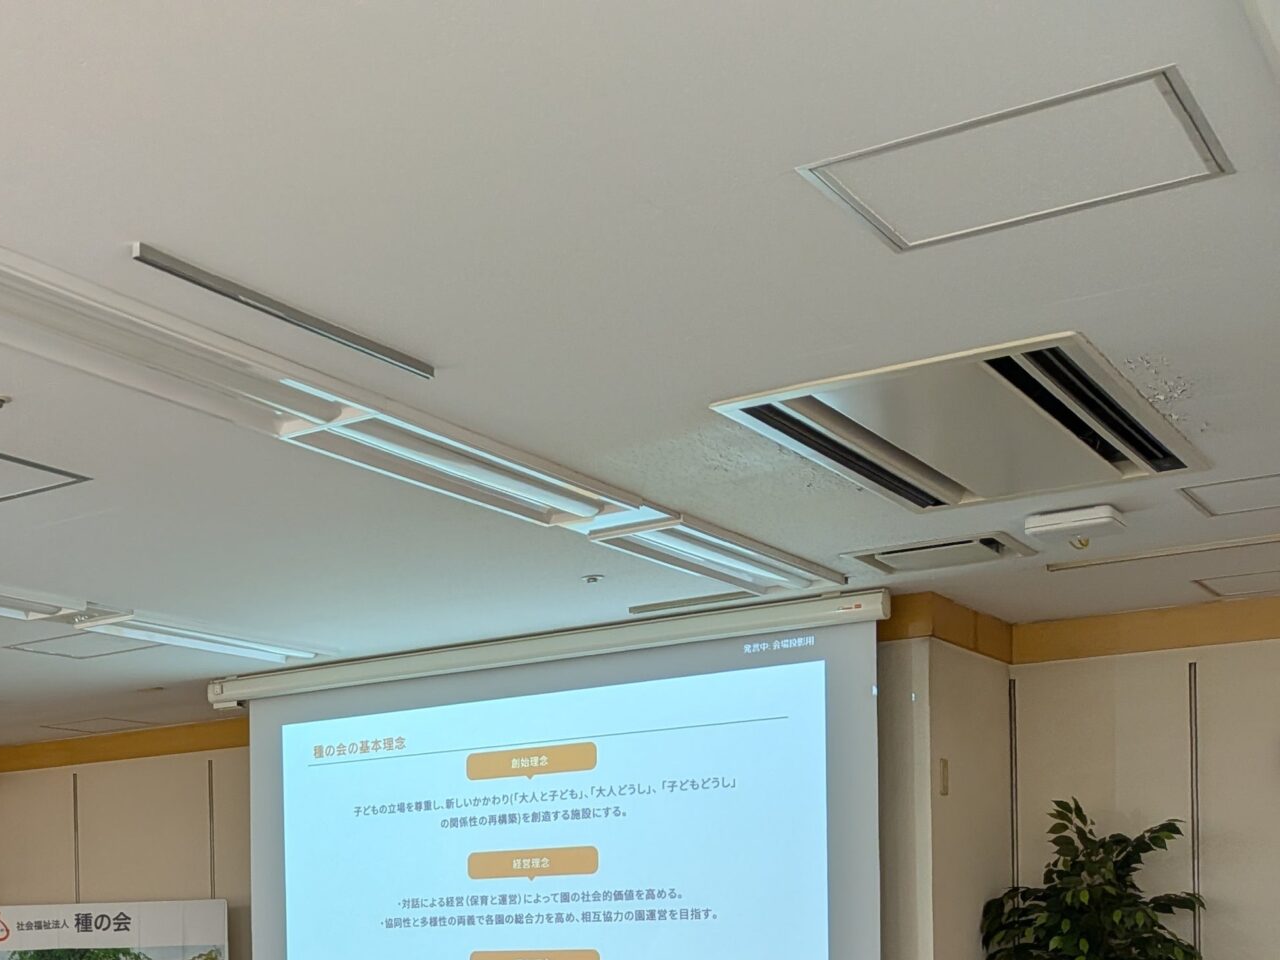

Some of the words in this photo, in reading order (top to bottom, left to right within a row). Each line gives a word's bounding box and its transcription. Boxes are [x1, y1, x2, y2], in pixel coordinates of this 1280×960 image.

[313, 736, 407, 759] 種の会の基本理念
[510, 755, 549, 769] 創始理念
[512, 857, 551, 870] 経営理念
[16, 919, 69, 932] 社会福祉法人
[74, 911, 131, 933] 種の会
